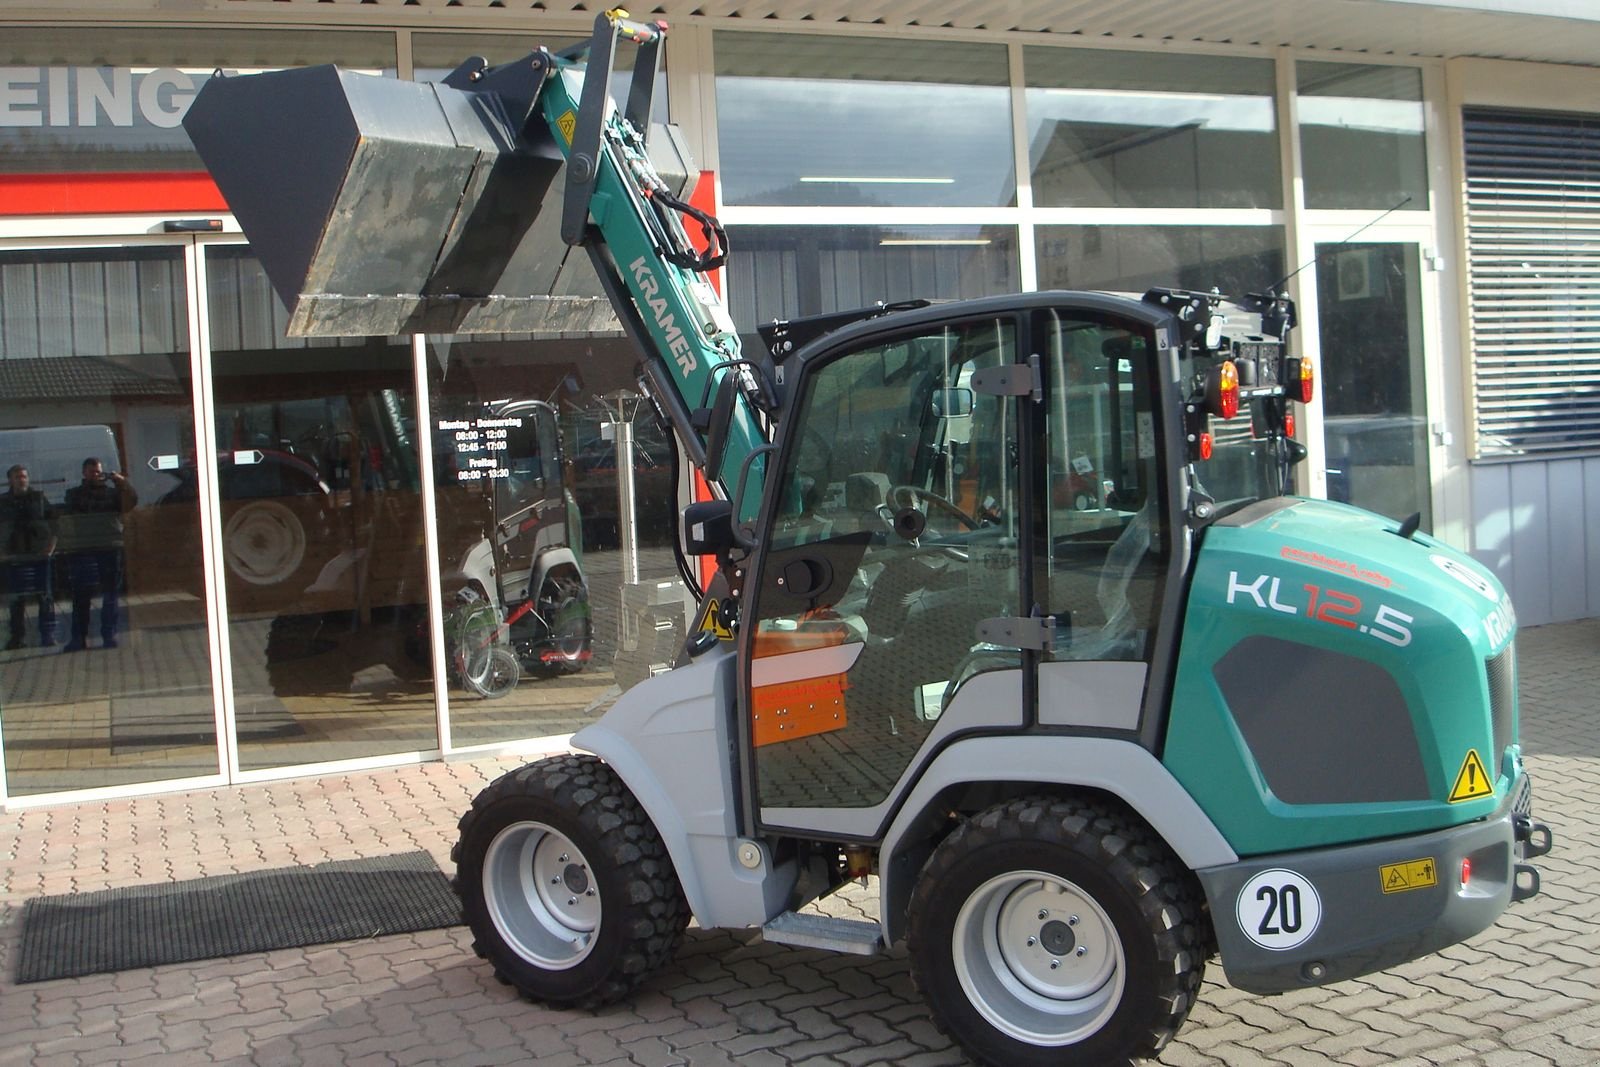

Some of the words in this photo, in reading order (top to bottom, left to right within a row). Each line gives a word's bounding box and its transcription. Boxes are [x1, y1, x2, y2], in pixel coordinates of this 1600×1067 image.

[0, 67, 239, 128] EING
[629, 256, 697, 378] KRAMER
[439, 420, 469, 430] Montag
[476, 417, 522, 428] Donnerstag
[456, 431, 478, 440] 08:00
[486, 430, 507, 439] 12:00
[457, 442, 479, 452] 12:45
[486, 441, 507, 451] 17:00
[469, 458, 497, 468] Freitag
[458, 470, 481, 480] 08:00
[488, 468, 509, 478] 13:30
[1257, 884, 1301, 935] 20
